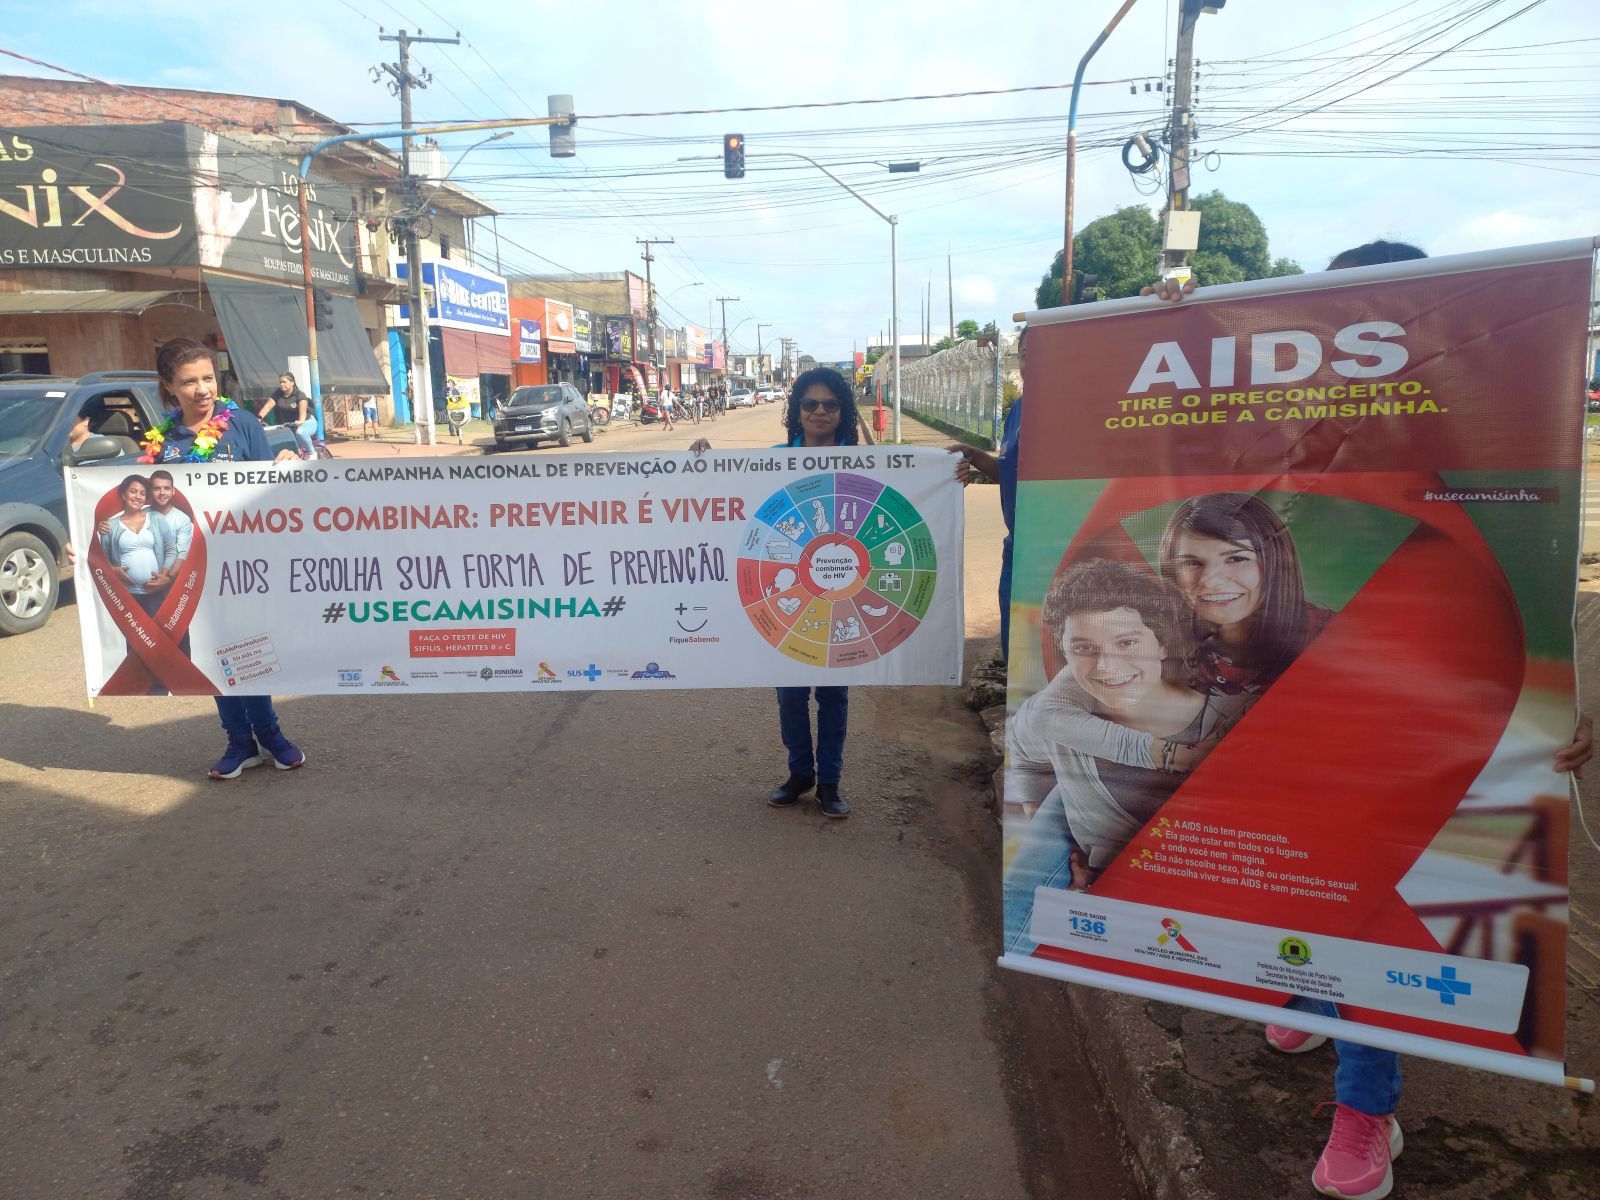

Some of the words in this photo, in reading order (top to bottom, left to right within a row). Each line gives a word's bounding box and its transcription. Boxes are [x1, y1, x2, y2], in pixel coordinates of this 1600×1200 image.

[282, 171, 316, 202] LOAS
[18, 249, 28, 264] E
[32, 247, 152, 264] MASCULINAS
[1127, 321, 1408, 394] AIDS
[1118, 394, 1173, 412] TIRE
[1181, 393, 1200, 408] O
[1210, 380, 1430, 406] PRECONCEITO.
[1104, 409, 1227, 430] COLOQUE
[1235, 408, 1255, 422] A
[1264, 399, 1448, 422] CAMISINHA.
[186, 472, 201, 486] 1º
[208, 472, 228, 486] DE
[235, 469, 328, 484] DEZEMBRO
[345, 466, 444, 483] CAMPANHA
[450, 464, 540, 479] NACIONAL
[547, 464, 568, 477] DE
[574, 458, 676, 478] PREVENÇÃO
[682, 460, 707, 473] AO
[714, 457, 782, 473] HIV/aids
[788, 457, 796, 470] E
[803, 454, 876, 470] OUTRAS
[887, 454, 916, 469] IST.
[1424, 489, 1541, 502] #usecamisinha
[204, 507, 304, 534] VAMOS
[313, 504, 478, 532] COMBINAR:
[490, 500, 628, 528] PREVENIR
[638, 492, 652, 524] É
[662, 497, 746, 523] VIVER
[219, 558, 270, 596] AIDS
[290, 556, 382, 592] ESCOLHA
[396, 556, 451, 590] SUA
[463, 553, 544, 588] FORMA
[564, 551, 594, 586] DE
[610, 542, 728, 586] PREVENÇÃO.
[96, 568, 124, 612] Camisinha
[124, 612, 156, 648] Pré-Natal
[164, 594, 188, 630] Tratamento
[322, 596, 626, 624] #USECAMISINHA#
[669, 636, 720, 644] FiqueSabendo
[1165, 830, 1178, 840] Ela
[1179, 833, 1199, 844] pode
[1202, 836, 1221, 846] estar
[1224, 840, 1236, 848] em
[1238, 841, 1261, 852] todos
[1276, 846, 1309, 859] lugares
[1174, 820, 1180, 828] A
[1181, 821, 1201, 832] AIDS
[1204, 824, 1218, 834] não
[1220, 827, 1236, 837] tem
[1238, 830, 1290, 844] preconceito.
[1168, 844, 1187, 853] onde
[1189, 846, 1208, 856] você
[1210, 850, 1228, 860] nem
[1232, 852, 1266, 866] imagina.
[1155, 852, 1167, 862] Ela
[1169, 854, 1183, 865] não
[1185, 857, 1216, 870] escolhe
[1218, 863, 1239, 873] sexo,
[1242, 865, 1264, 877] idade
[1266, 870, 1278, 879] ou
[1280, 872, 1325, 887] orientação
[1328, 879, 1359, 892] sexual.
[1200, 873, 1219, 882] viver
[1221, 876, 1239, 886] sem
[1240, 878, 1261, 889] AIDS
[1270, 884, 1288, 893] sem
[1290, 886, 1350, 902] preconceitos.
[1069, 916, 1106, 935] 136
[1386, 969, 1422, 988] SUS
[1329, 990, 1344, 998] Saúde
